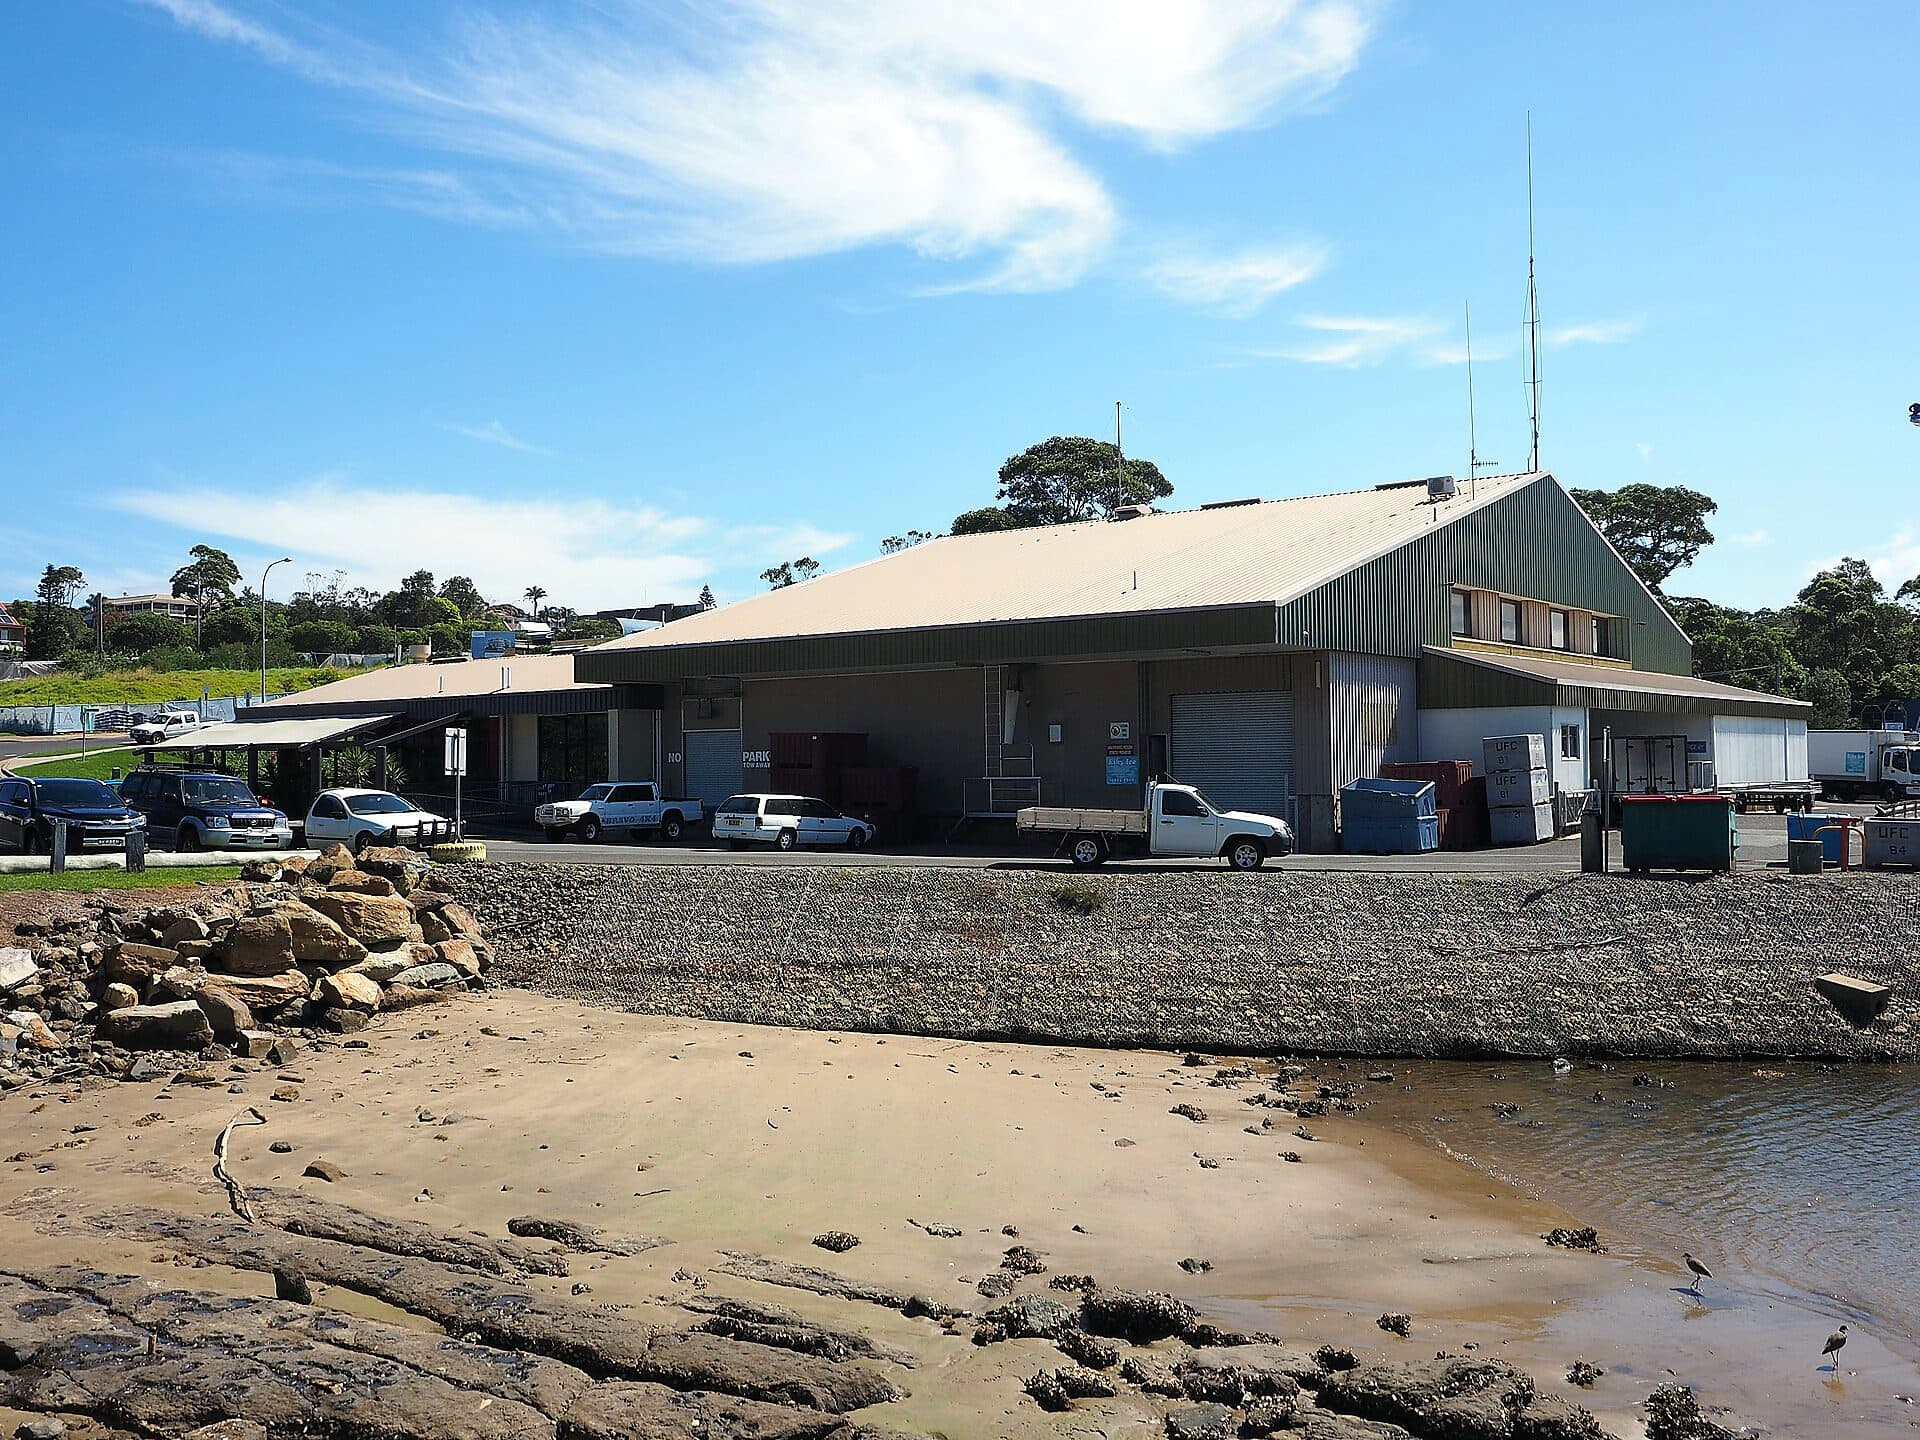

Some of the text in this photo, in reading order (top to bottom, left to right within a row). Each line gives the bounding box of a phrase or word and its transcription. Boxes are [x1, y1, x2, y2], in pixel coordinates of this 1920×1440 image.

[1496, 741, 1517, 751] UFC
[668, 752, 681, 762] NO
[742, 751, 771, 762] PARK
[1495, 776, 1517, 786] UFC
[1879, 826, 1909, 839] UFC
